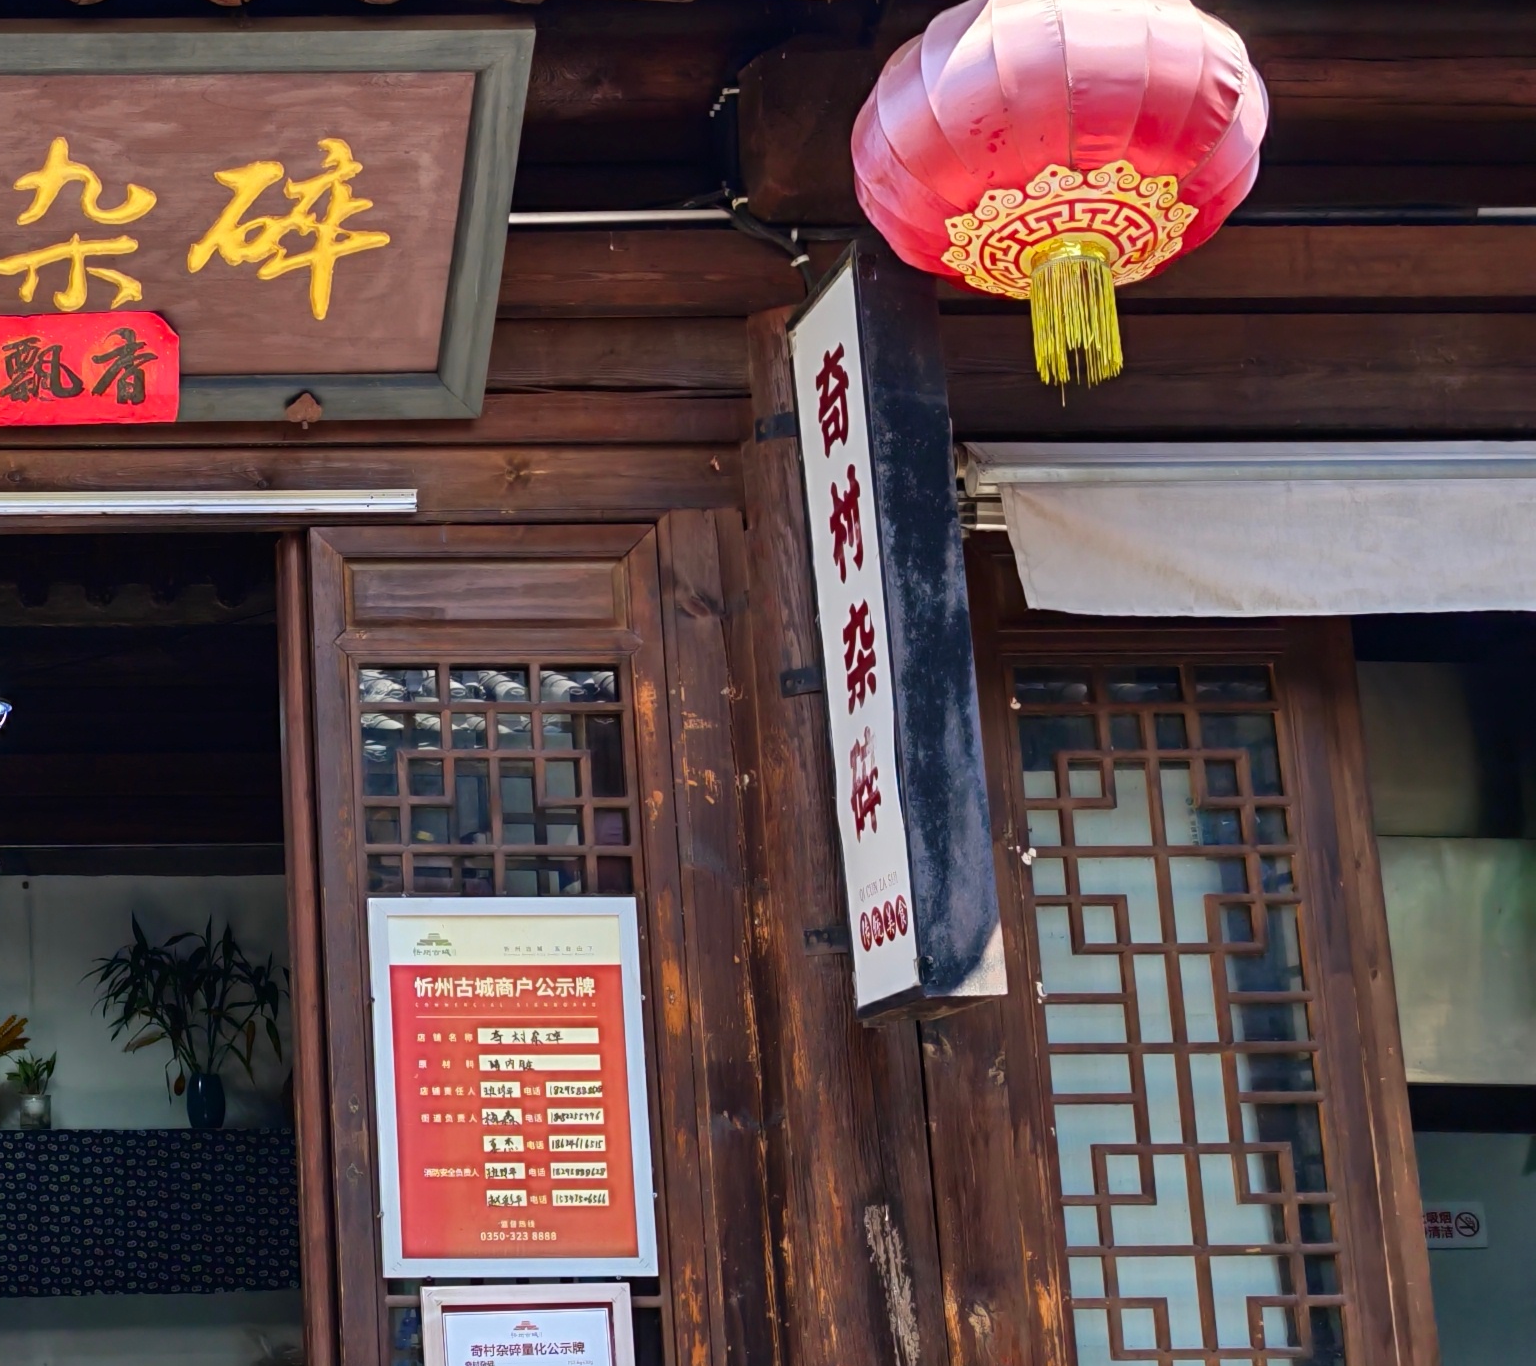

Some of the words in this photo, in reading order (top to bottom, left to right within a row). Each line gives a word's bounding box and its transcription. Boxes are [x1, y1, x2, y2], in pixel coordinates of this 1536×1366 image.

[815, 341, 883, 843] 奇村杂碎
[861, 898, 907, 947] 传统美食
[414, 976, 596, 998] 忻州古城商户公示牌
[417, 1032, 474, 1043] 店铺名称
[418, 1059, 475, 1069] 原材料
[419, 1085, 476, 1096] 店铺责任人
[523, 1086, 541, 1096] 电话
[421, 1113, 478, 1123] 街道负责人
[525, 1113, 543, 1123] 电话
[526, 1140, 545, 1150] 电话
[423, 1167, 480, 1177] 消防安全负责人
[528, 1167, 546, 1177] 电话
[529, 1195, 547, 1205] 电话
[1423, 1211, 1452, 1225] 吸烟
[480, 1231, 528, 1241] 0350-323
[531, 1231, 557, 1241] 8888
[470, 1341, 585, 1357] 奇村杂碎量化公示牌
